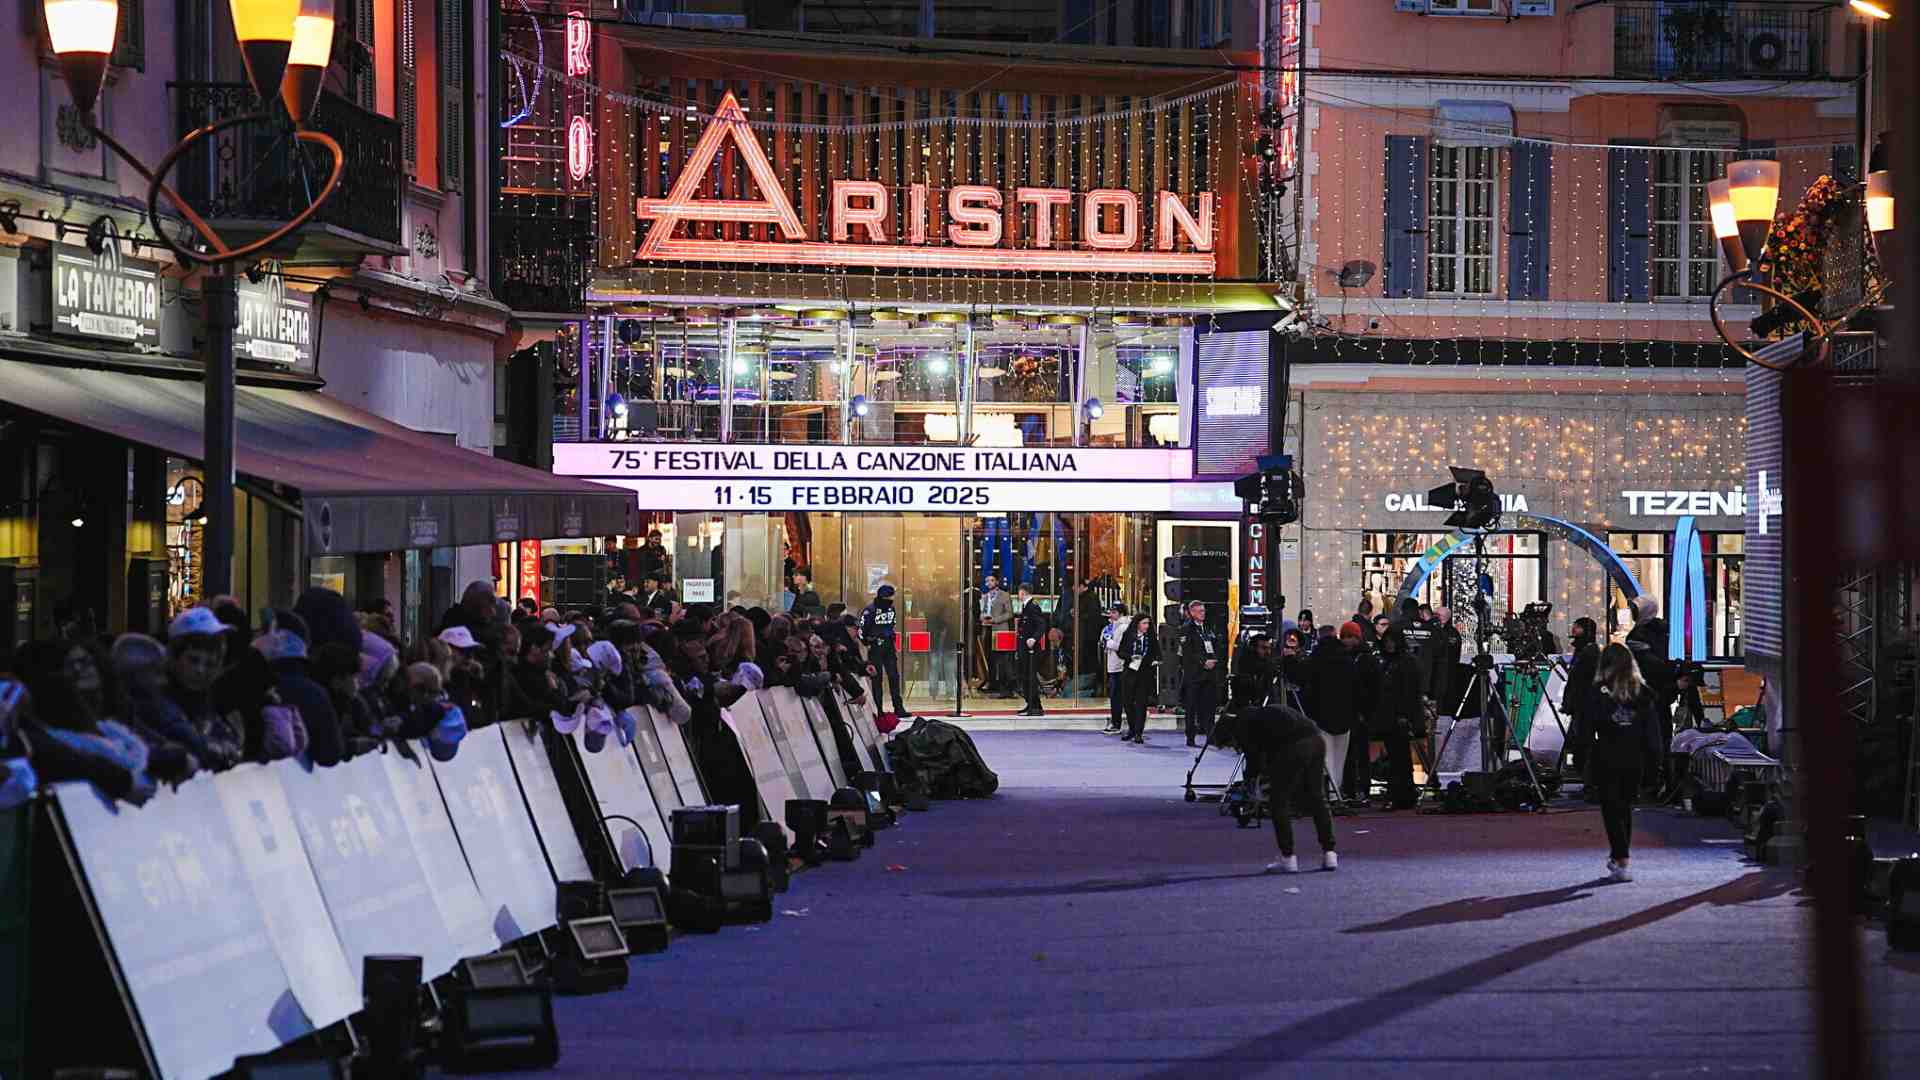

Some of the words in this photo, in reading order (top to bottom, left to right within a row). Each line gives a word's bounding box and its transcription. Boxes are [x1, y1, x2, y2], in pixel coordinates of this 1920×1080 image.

[635, 90, 1214, 266] ARISTON
[57, 266, 79, 308] LA
[83, 271, 156, 321] TAVERNA
[256, 303, 310, 345] TAVERNA
[653, 451, 764, 470] FESTIVAL
[774, 452, 848, 471] DELLA
[857, 452, 965, 471] CANZONE
[975, 453, 1078, 472] ITALIANA
[792, 486, 913, 505] FEBBRAIO
[927, 486, 990, 505] 2025
[1384, 493, 1529, 512] CALIA
